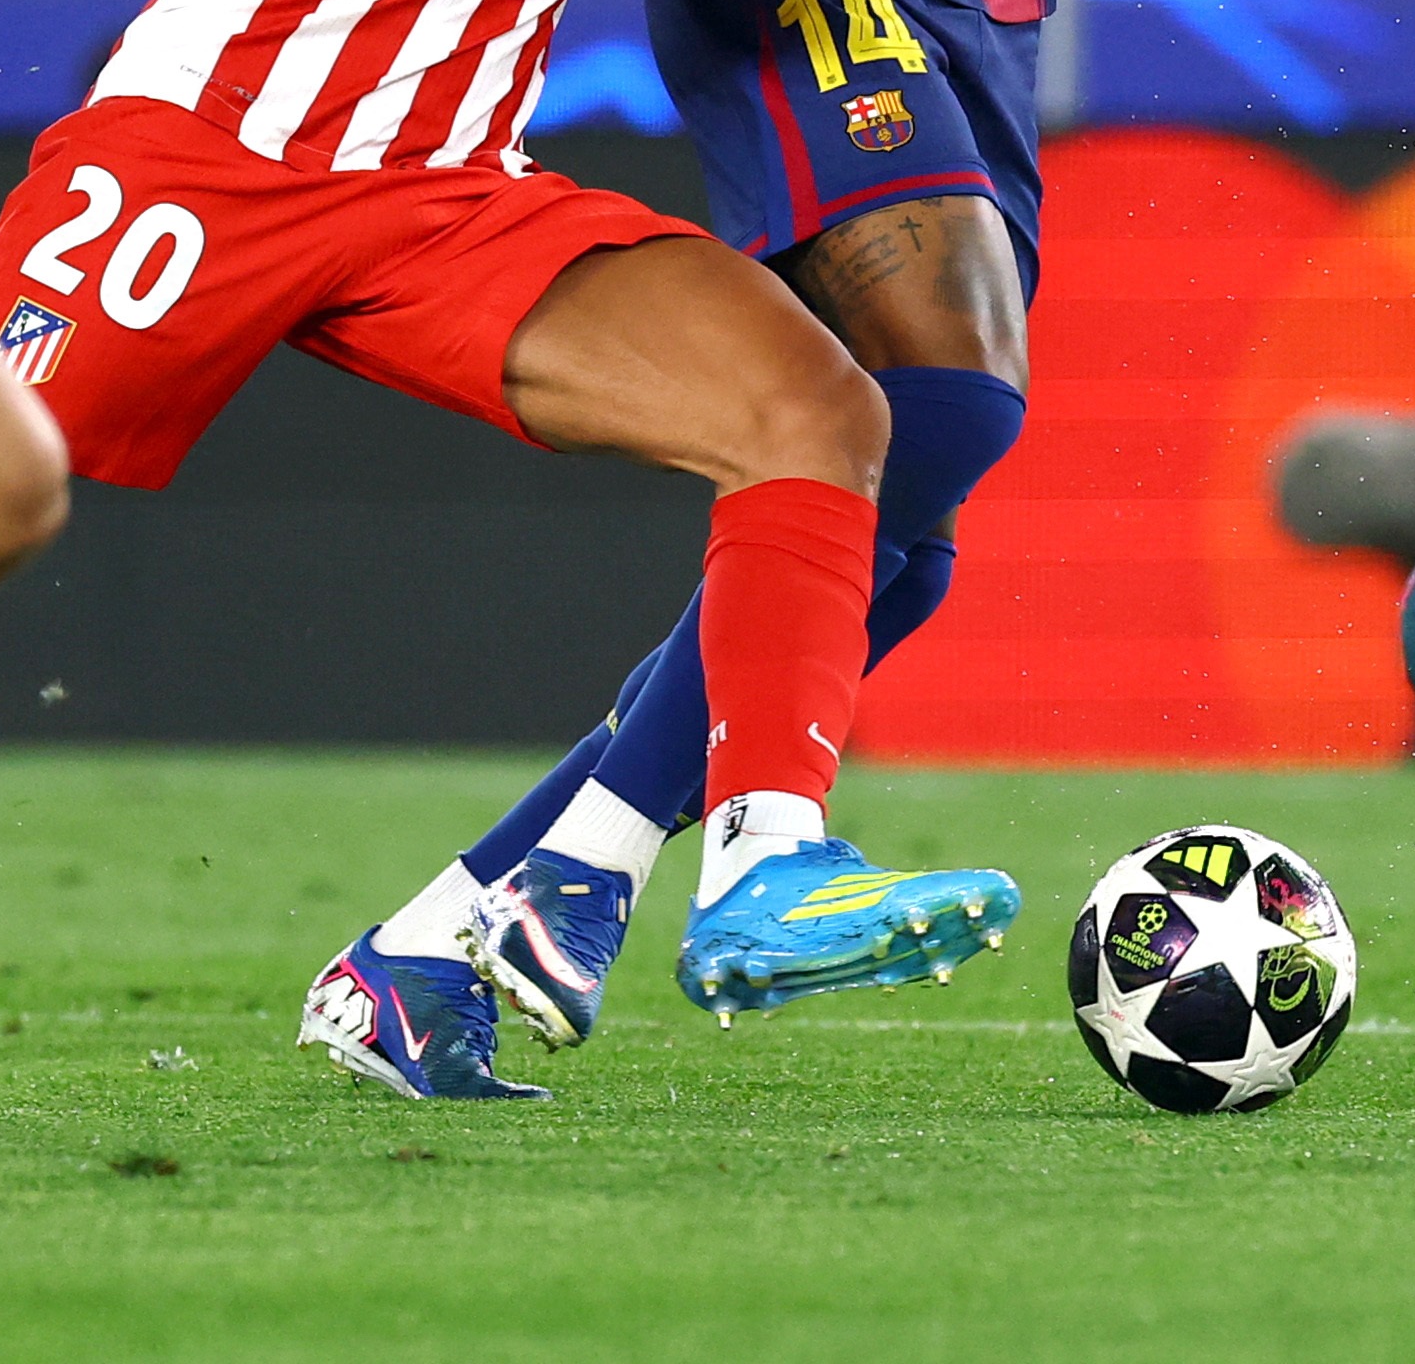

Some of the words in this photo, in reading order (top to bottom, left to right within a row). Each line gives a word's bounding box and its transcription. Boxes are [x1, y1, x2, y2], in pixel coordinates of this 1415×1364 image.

[866, 113, 893, 126] FCB
[19, 164, 206, 330] 20
[1111, 933, 1165, 966] CHAMPIONS
[1115, 946, 1151, 971] LEAGUE
